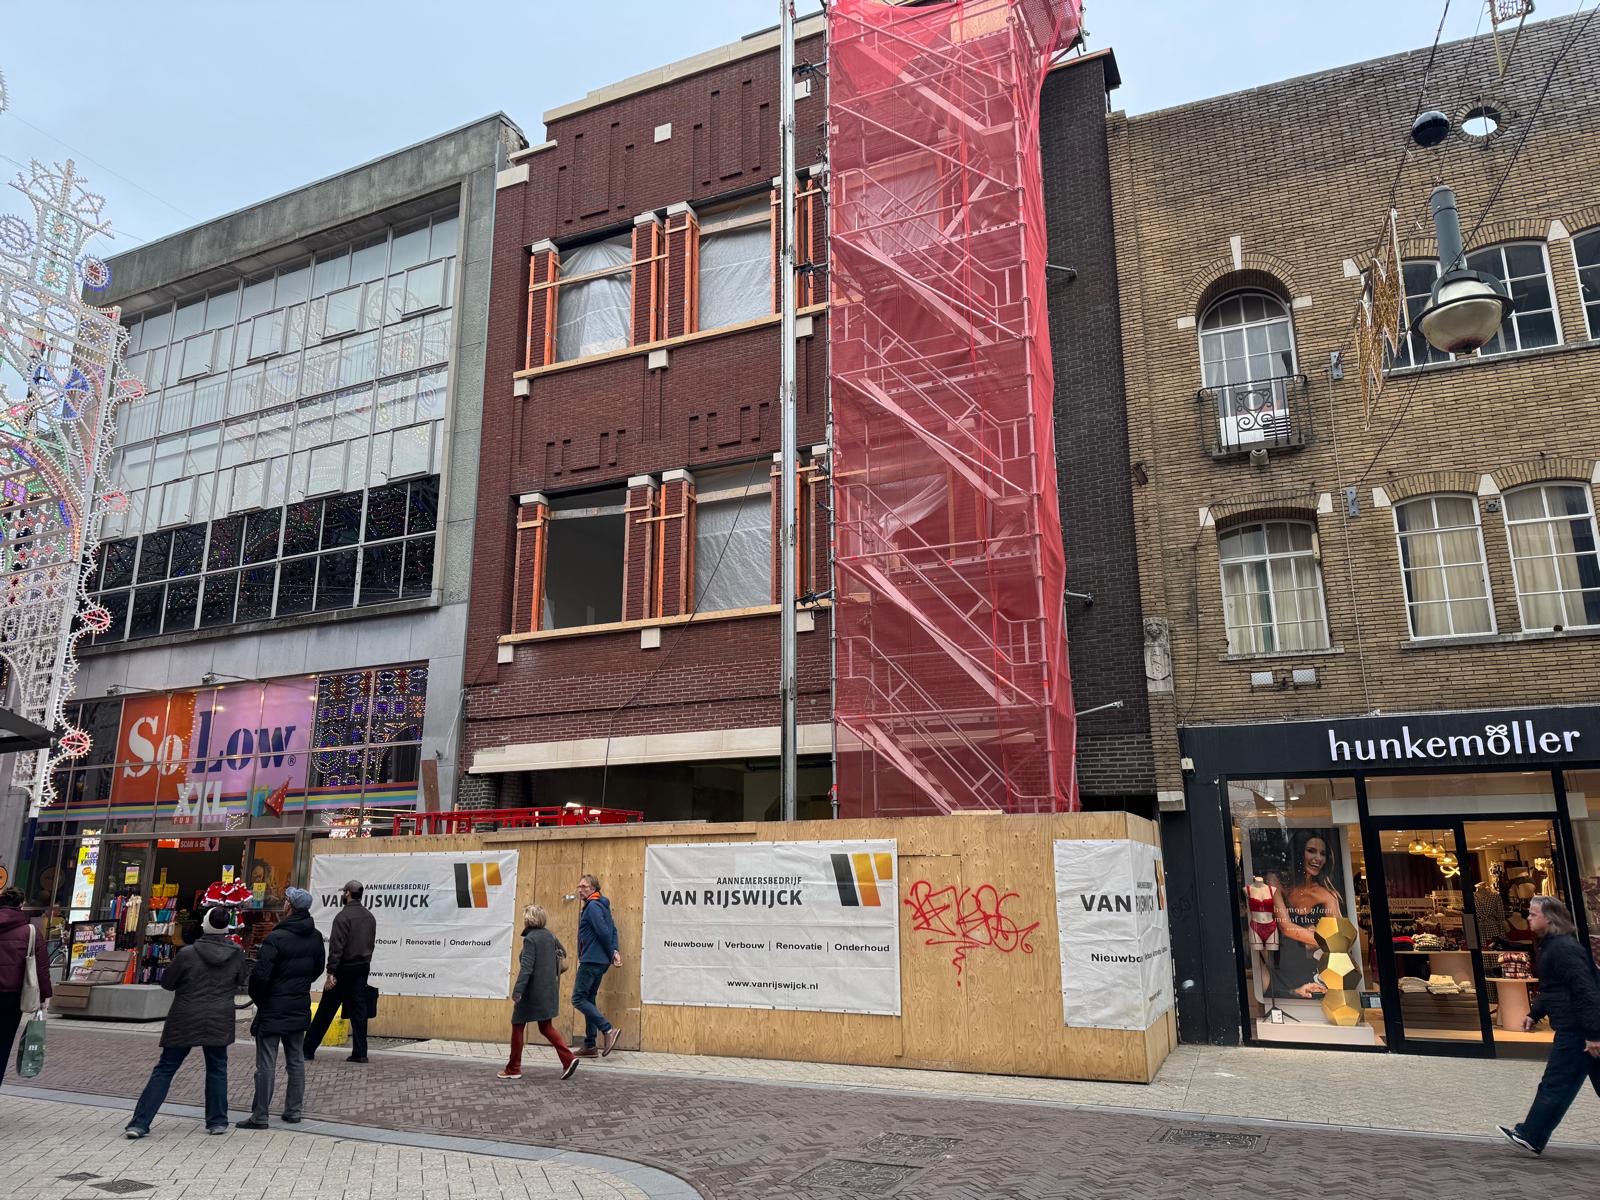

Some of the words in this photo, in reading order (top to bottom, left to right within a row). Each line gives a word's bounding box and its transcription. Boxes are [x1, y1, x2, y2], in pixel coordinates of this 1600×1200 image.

[1328, 719, 1580, 762] hunkemöller
[172, 780, 228, 817] XXL
[365, 883, 431, 891] AANNEMERSBEDRIJF
[716, 876, 803, 886] AANNEMERSBEDRIJF
[363, 894, 430, 911] IJSWIJCK
[660, 890, 697, 906] VAN
[703, 889, 803, 909] RIJSWIJCK
[1080, 894, 1132, 913] VAN
[405, 938, 441, 946] Renovatie
[663, 939, 714, 948] Nieuwbouw
[724, 940, 765, 950] Verbouw
[776, 942, 823, 951] Renovatie
[834, 943, 890, 952] Onderhoud
[726, 980, 819, 991] www.vanrijswijck.nl
